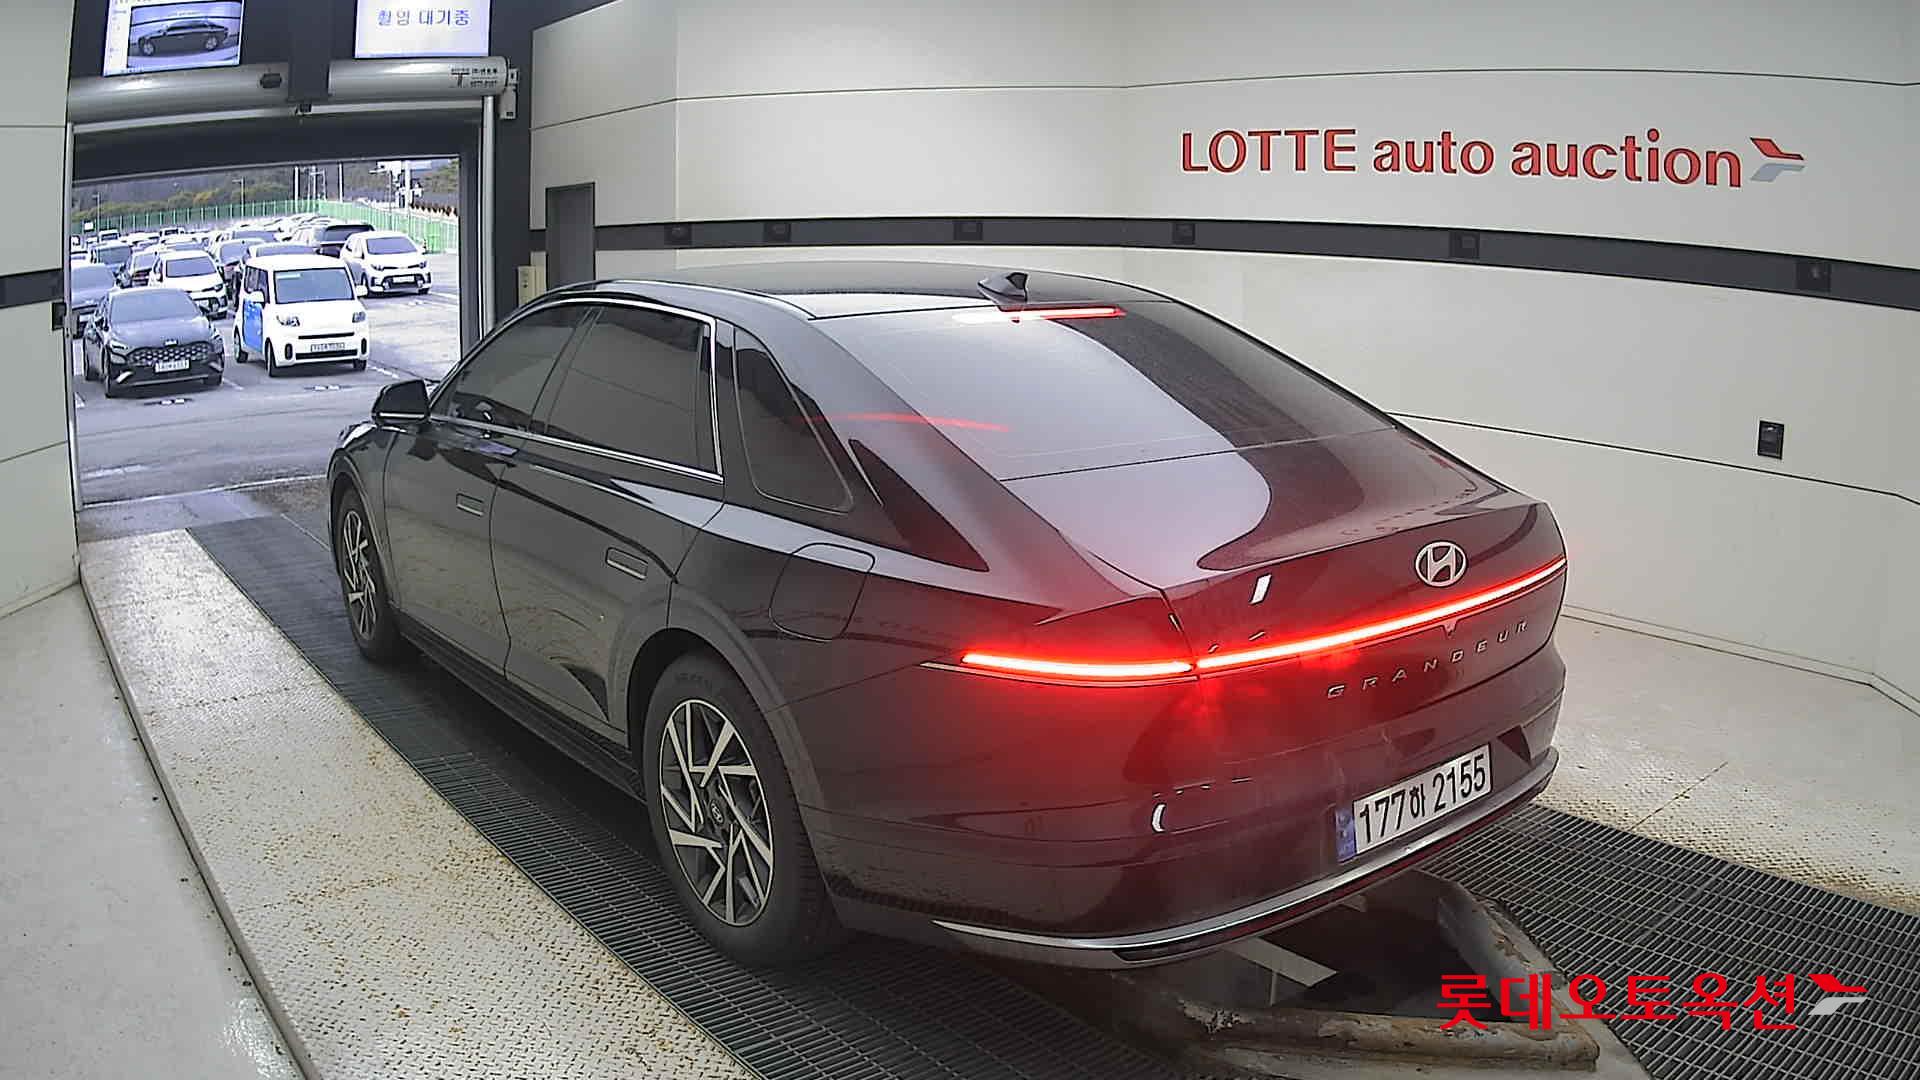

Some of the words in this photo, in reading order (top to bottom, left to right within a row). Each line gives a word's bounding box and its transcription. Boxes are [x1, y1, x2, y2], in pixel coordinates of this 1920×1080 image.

[418, 8, 471, 27] 대기중
[1182, 129, 1357, 173] LOTTE
[1373, 131, 1495, 176] auto
[1510, 128, 1742, 189] auction
[1326, 619, 1529, 700] GRANDEUR
[1359, 783, 1426, 844] 177하
[1433, 753, 1487, 813] 2155
